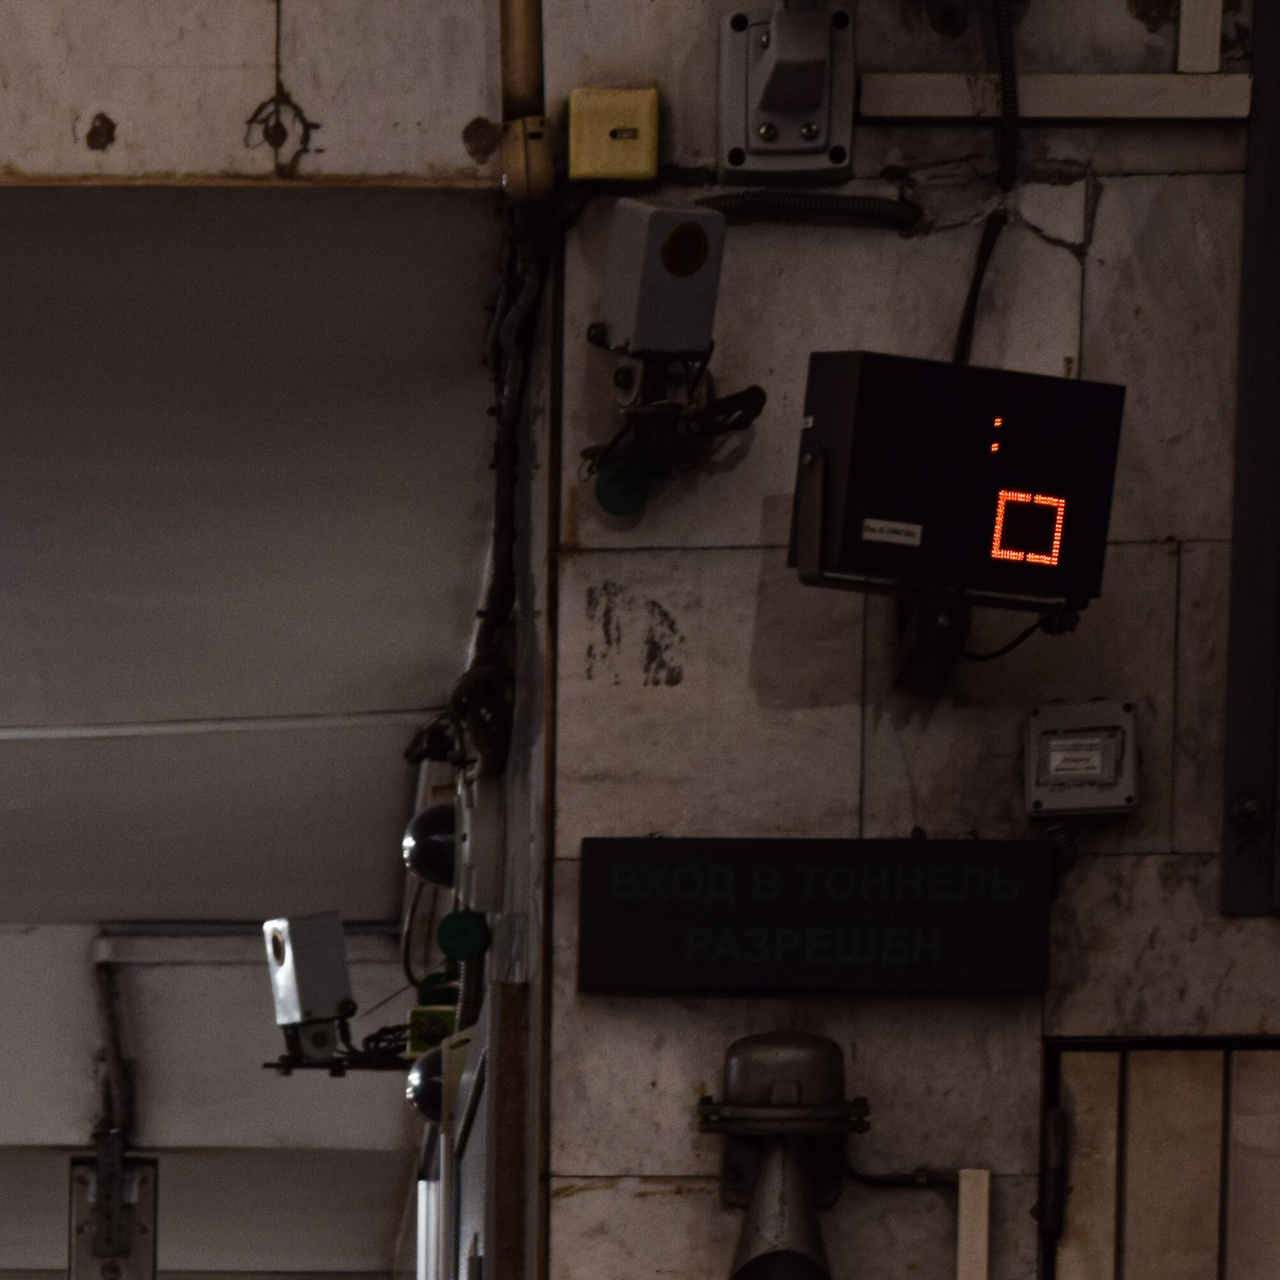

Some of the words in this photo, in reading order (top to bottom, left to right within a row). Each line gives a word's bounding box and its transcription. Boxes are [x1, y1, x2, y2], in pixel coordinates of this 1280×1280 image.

[610, 864, 736, 906] ВХОД
[752, 865, 780, 900] В
[792, 864, 1020, 902] ТОННЕЛЬ
[685, 926, 942, 964] РАЗРЕШЕН
